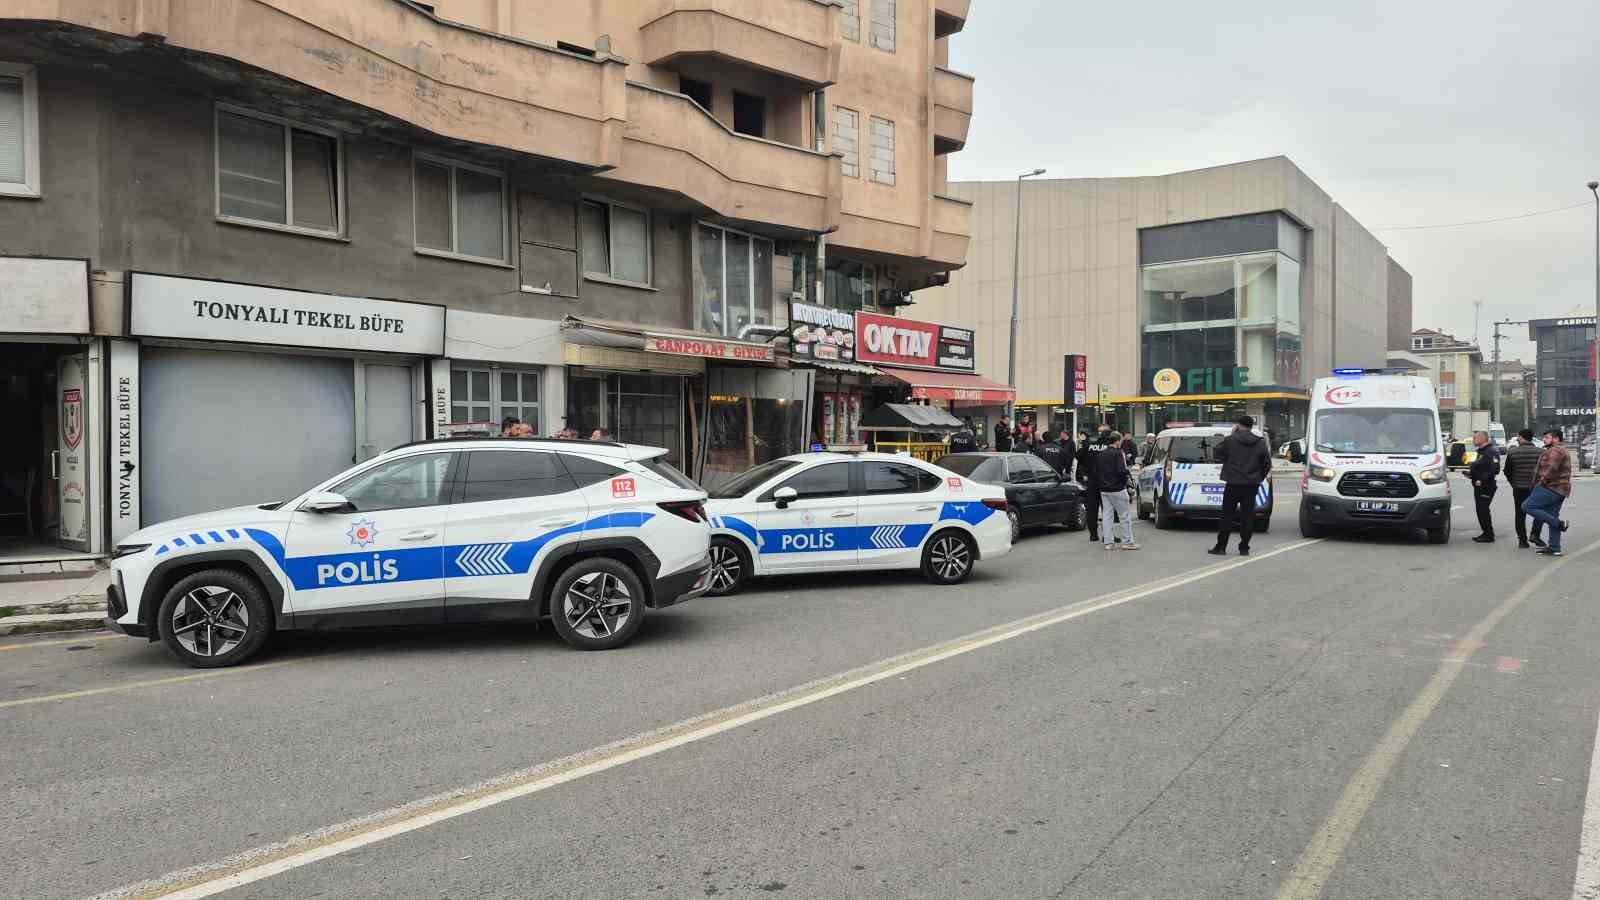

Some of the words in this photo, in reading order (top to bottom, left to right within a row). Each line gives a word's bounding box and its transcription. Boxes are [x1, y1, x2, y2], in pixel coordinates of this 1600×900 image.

[193, 300, 289, 325] TONYALI
[294, 310, 356, 330] TEKEL
[359, 313, 405, 334] BÜFE
[863, 323, 934, 359] OKTAY
[116, 376, 130, 411] BÜFE
[1336, 391, 1361, 399] 112
[119, 414, 131, 456] TEKEL
[615, 481, 632, 491] 112
[780, 529, 835, 549] POLİS
[317, 553, 399, 585] POLİS
